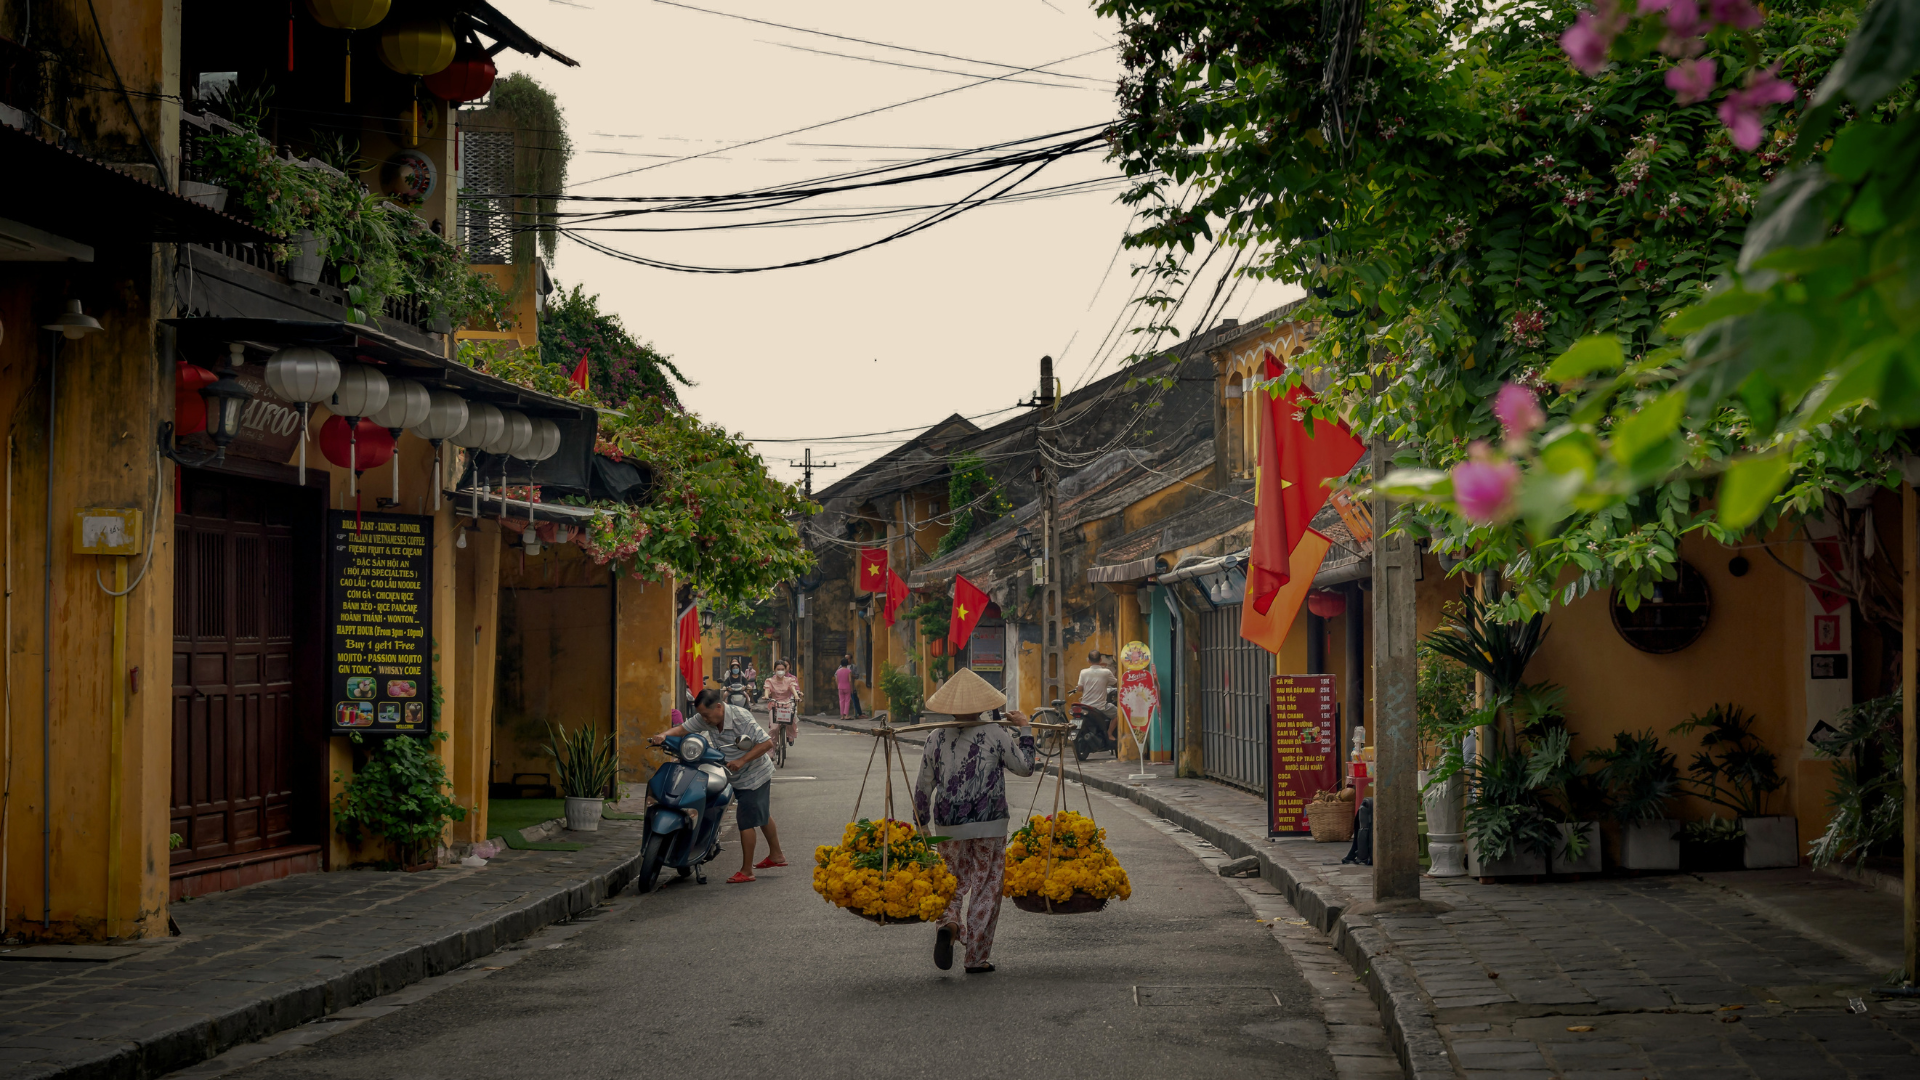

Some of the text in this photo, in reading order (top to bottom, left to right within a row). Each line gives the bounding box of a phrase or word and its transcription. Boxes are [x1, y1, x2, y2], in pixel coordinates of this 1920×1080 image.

[240, 399, 300, 437] AIFOO
[342, 520, 420, 533] BREAFAST LUNCH DINNER
[407, 536, 425, 546] COFFEE
[349, 545, 422, 558] FRESH FRUIT & ICE CREAM
[361, 568, 370, 576] AN
[340, 578, 353, 586] CAO
[371, 580, 383, 588] CAO
[398, 581, 421, 589] NOODLE
[362, 588, 371, 599] GÀ
[376, 592, 400, 602] CHICKEN
[401, 592, 414, 602] RICE
[377, 603, 390, 613] RICE
[391, 604, 418, 614] PANCAKE
[387, 615, 413, 623] WONTON
[337, 625, 356, 635] HAPPY
[357, 626, 373, 635] HOUR
[392, 629, 403, 638] 3pm
[345, 639, 365, 651] Buy
[367, 641, 372, 649] 1
[395, 641, 415, 650] Free
[337, 653, 422, 664] MOJITO PASSION MOJITO
[338, 665, 421, 675] GIN TONIC WHISKY COKE
